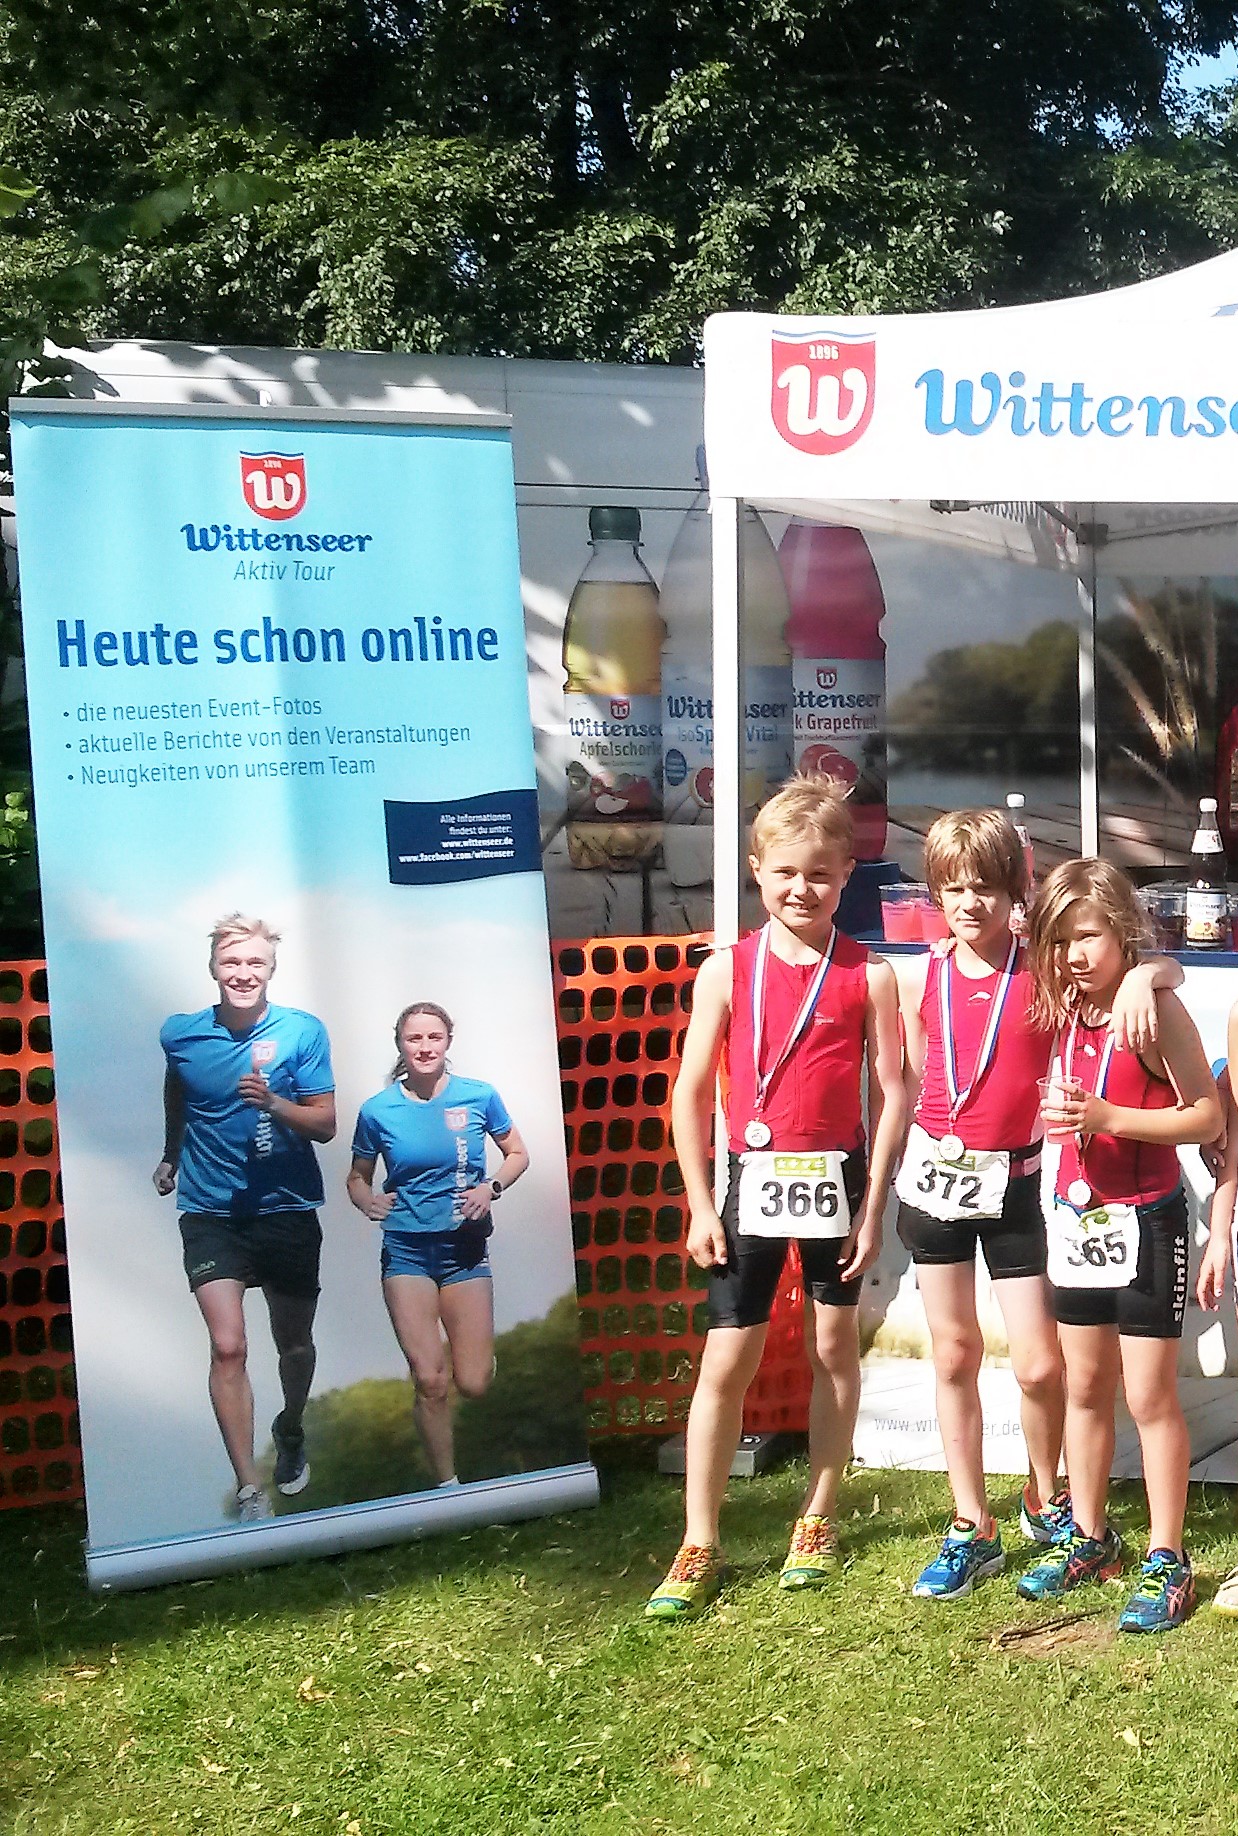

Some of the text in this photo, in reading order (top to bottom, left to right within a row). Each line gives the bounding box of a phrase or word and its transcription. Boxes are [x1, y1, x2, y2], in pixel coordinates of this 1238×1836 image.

[808, 345, 840, 362] 1896
[180, 523, 373, 553] Wittenseer
[234, 561, 335, 581] Aktiv Tour
[57, 616, 499, 668] Heute schon online
[77, 696, 322, 722] die neuesten Event-Fotos
[78, 723, 471, 753] aktuelle Berichte von den Veranstaltungen
[569, 717, 662, 737] Wittense
[81, 756, 376, 788] Neuigkeiten von unserem Team
[398, 850, 515, 862] www.facebook.com/wittenseer
[440, 836, 514, 848] www.wittenseer.de
[761, 1181, 839, 1218] 366
[916, 1160, 983, 1209] 372
[1064, 1230, 1127, 1267] 365
[1172, 1235, 1186, 1322] skinfit
[874, 1416, 1021, 1438] www.witer.de
